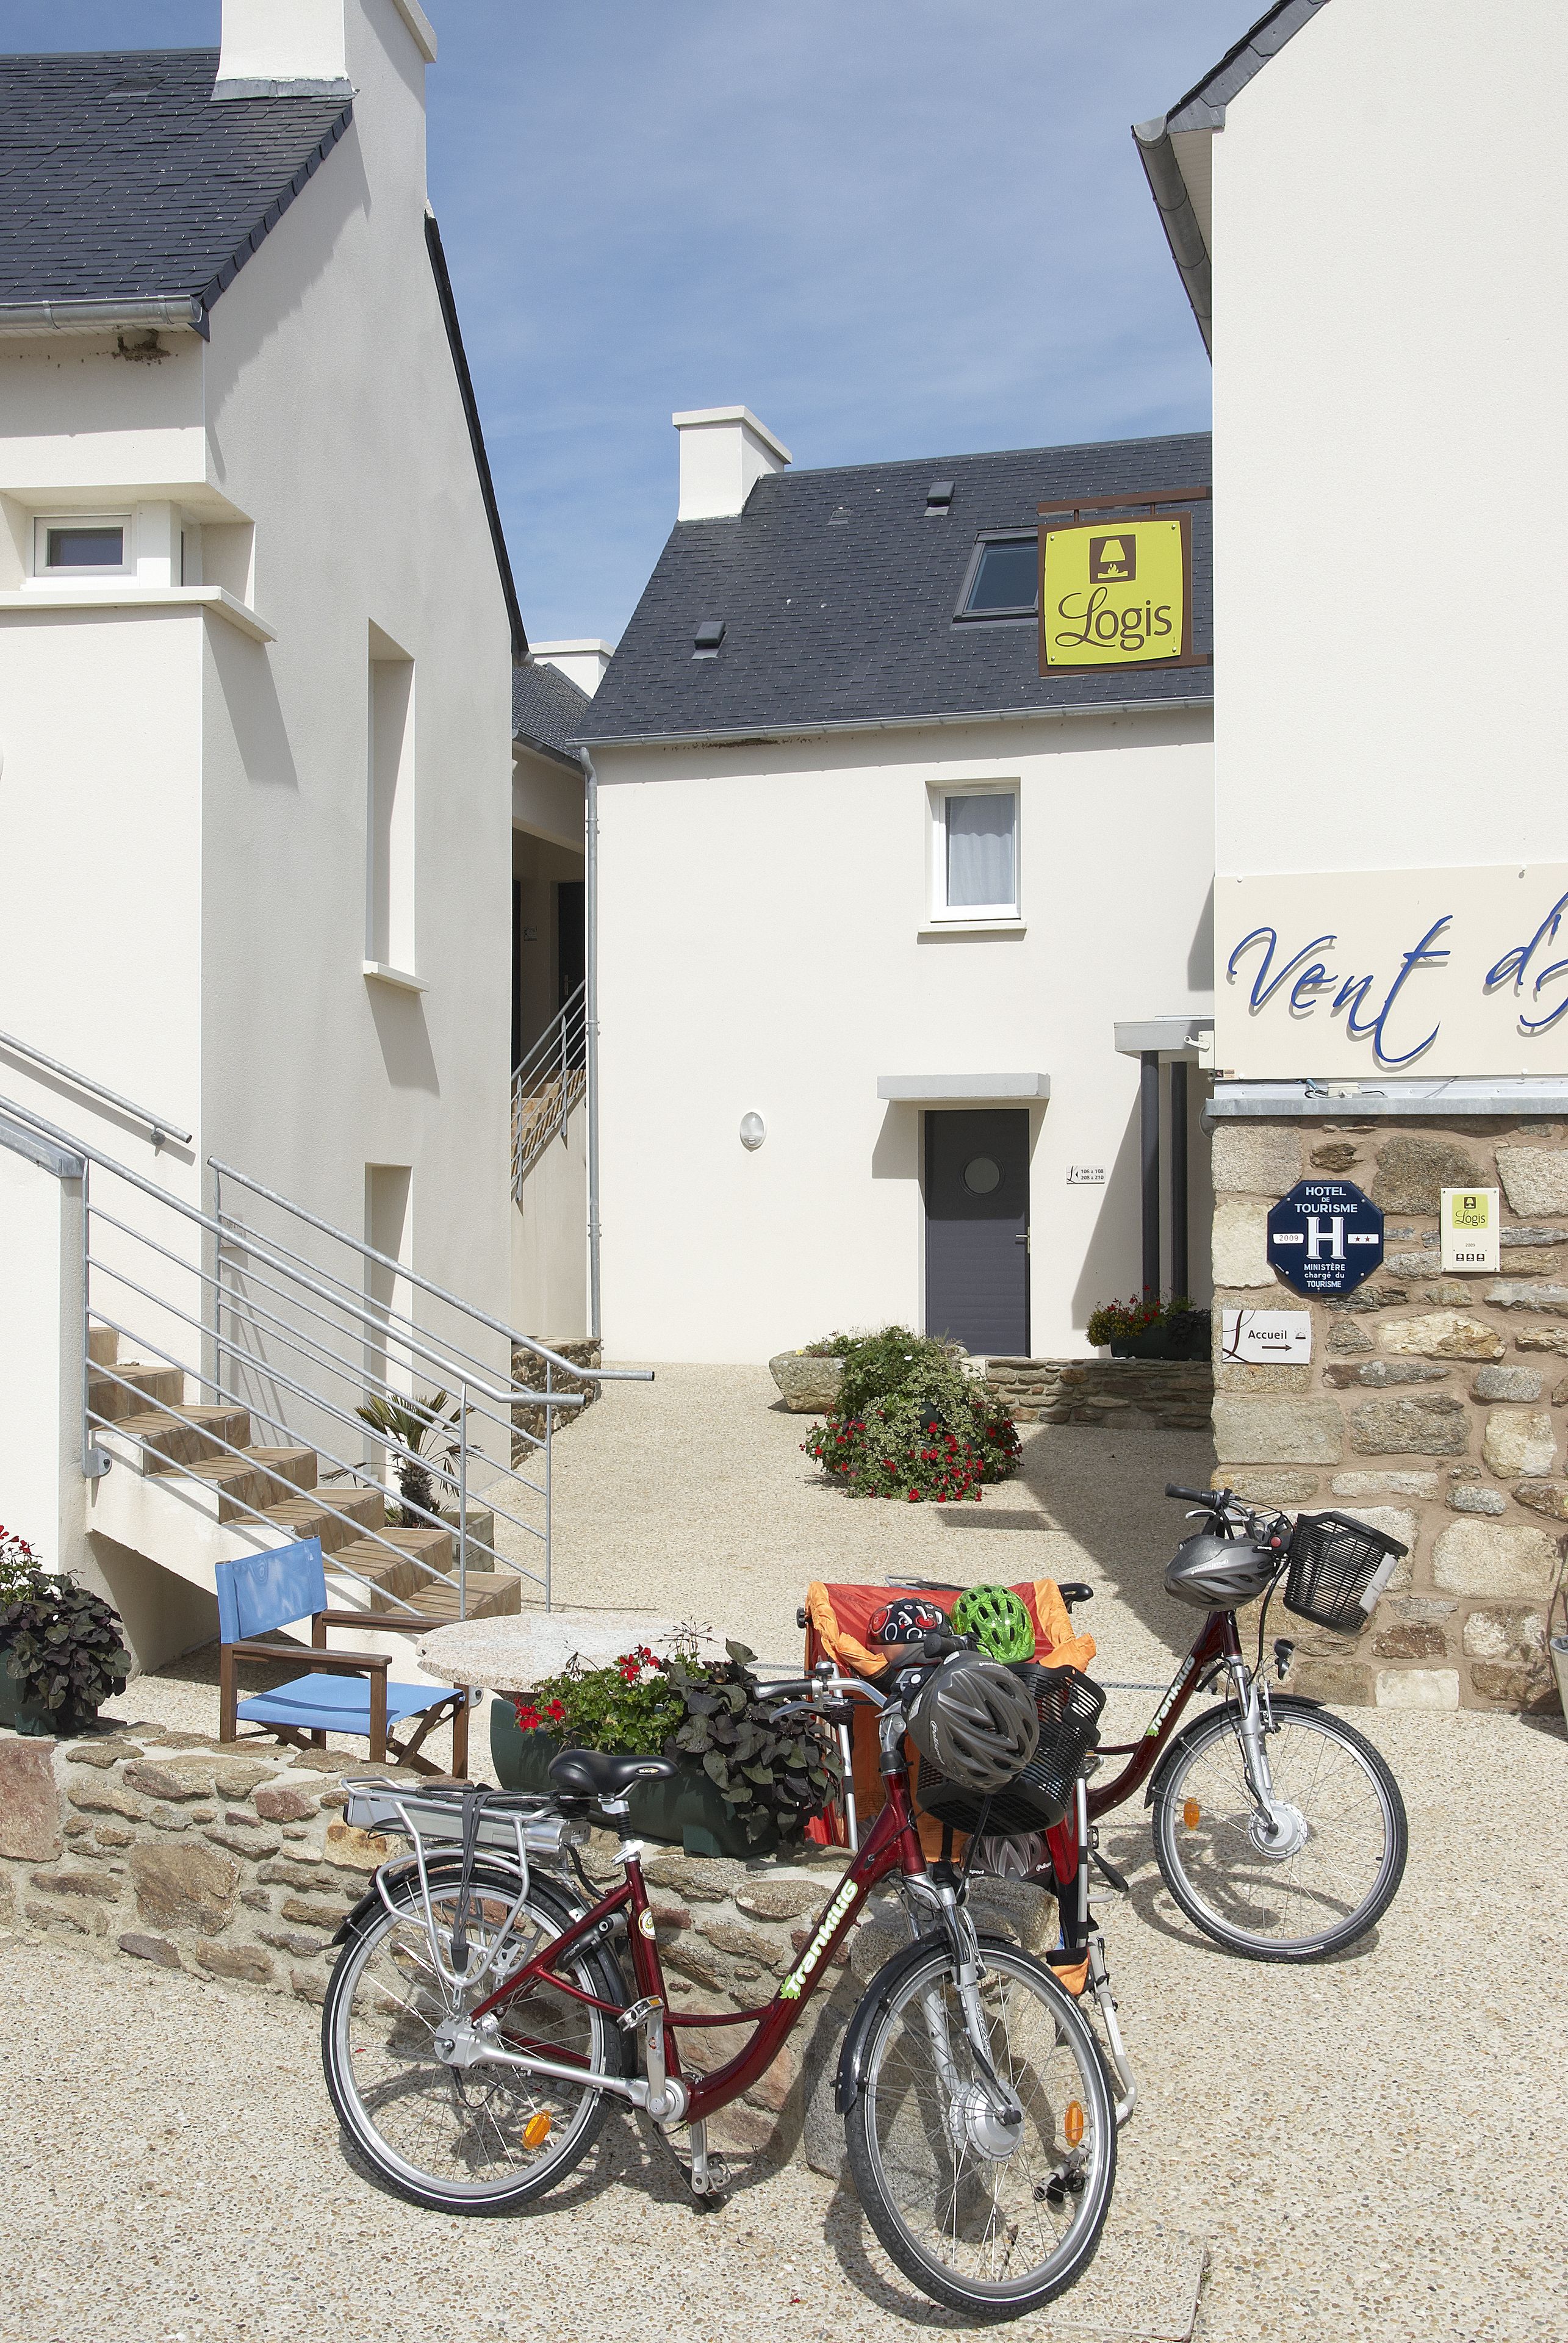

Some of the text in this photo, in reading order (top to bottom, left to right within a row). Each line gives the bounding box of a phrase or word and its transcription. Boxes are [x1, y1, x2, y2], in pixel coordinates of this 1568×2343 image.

[1055, 586, 1173, 652] Logis
[1228, 915, 1453, 1063] Vent
[1305, 1186, 1347, 1197] HOTEL
[1294, 1203, 1358, 1213] TOURISME
[1455, 1209, 1486, 1226] Logis
[1306, 1216, 1347, 1259] H
[1304, 1262, 1345, 1271] MINISTÈRE
[1304, 1271, 1332, 1279] chargé
[1248, 1330, 1287, 1339] Accueil
